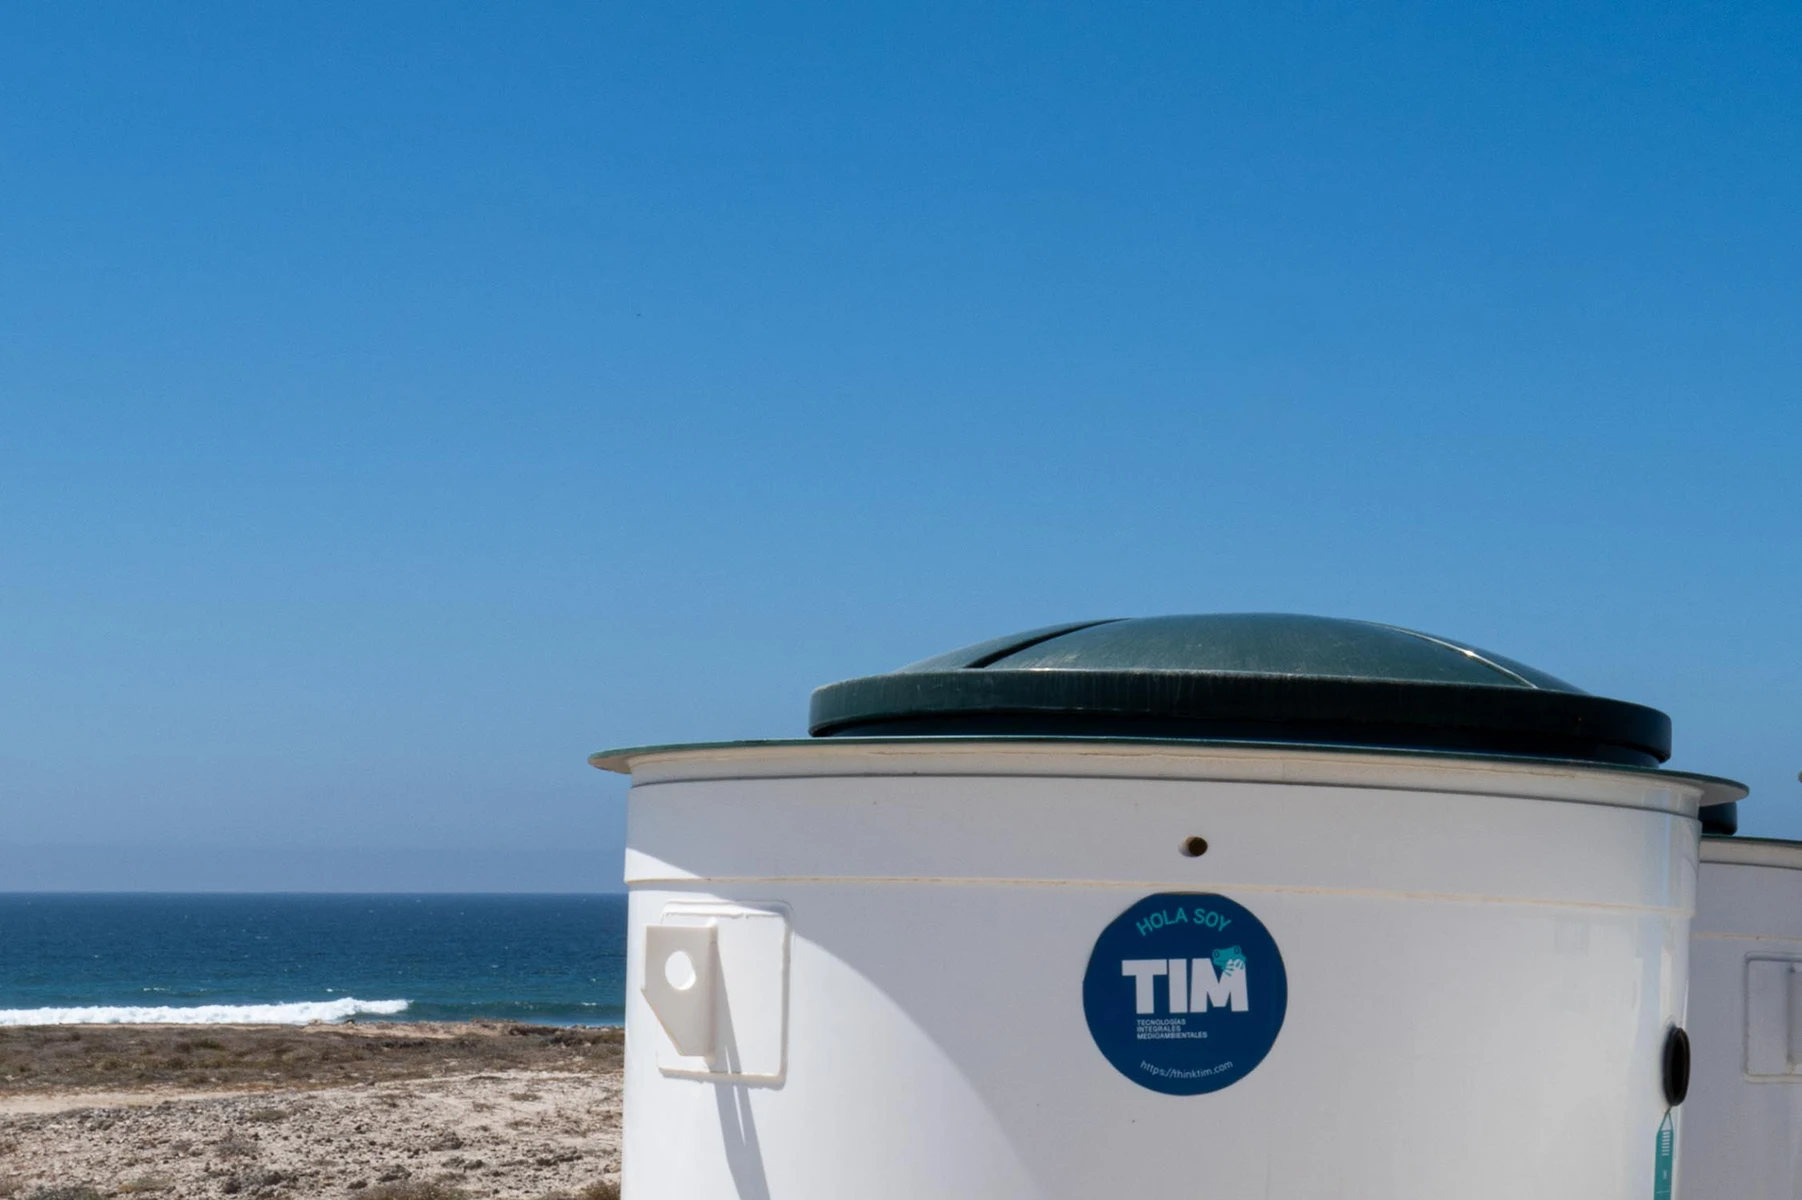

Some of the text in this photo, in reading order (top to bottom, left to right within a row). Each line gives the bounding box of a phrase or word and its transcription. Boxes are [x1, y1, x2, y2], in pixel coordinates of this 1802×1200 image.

[1136, 906, 1232, 936] HOLA SOY
[1121, 957, 1249, 1015] TIM
[1136, 1018, 1187, 1026] TECNOLOGÍAS
[1136, 1025, 1182, 1033] INTEGRALES
[1136, 1031, 1208, 1040] MEDIOAMBIENTALES
